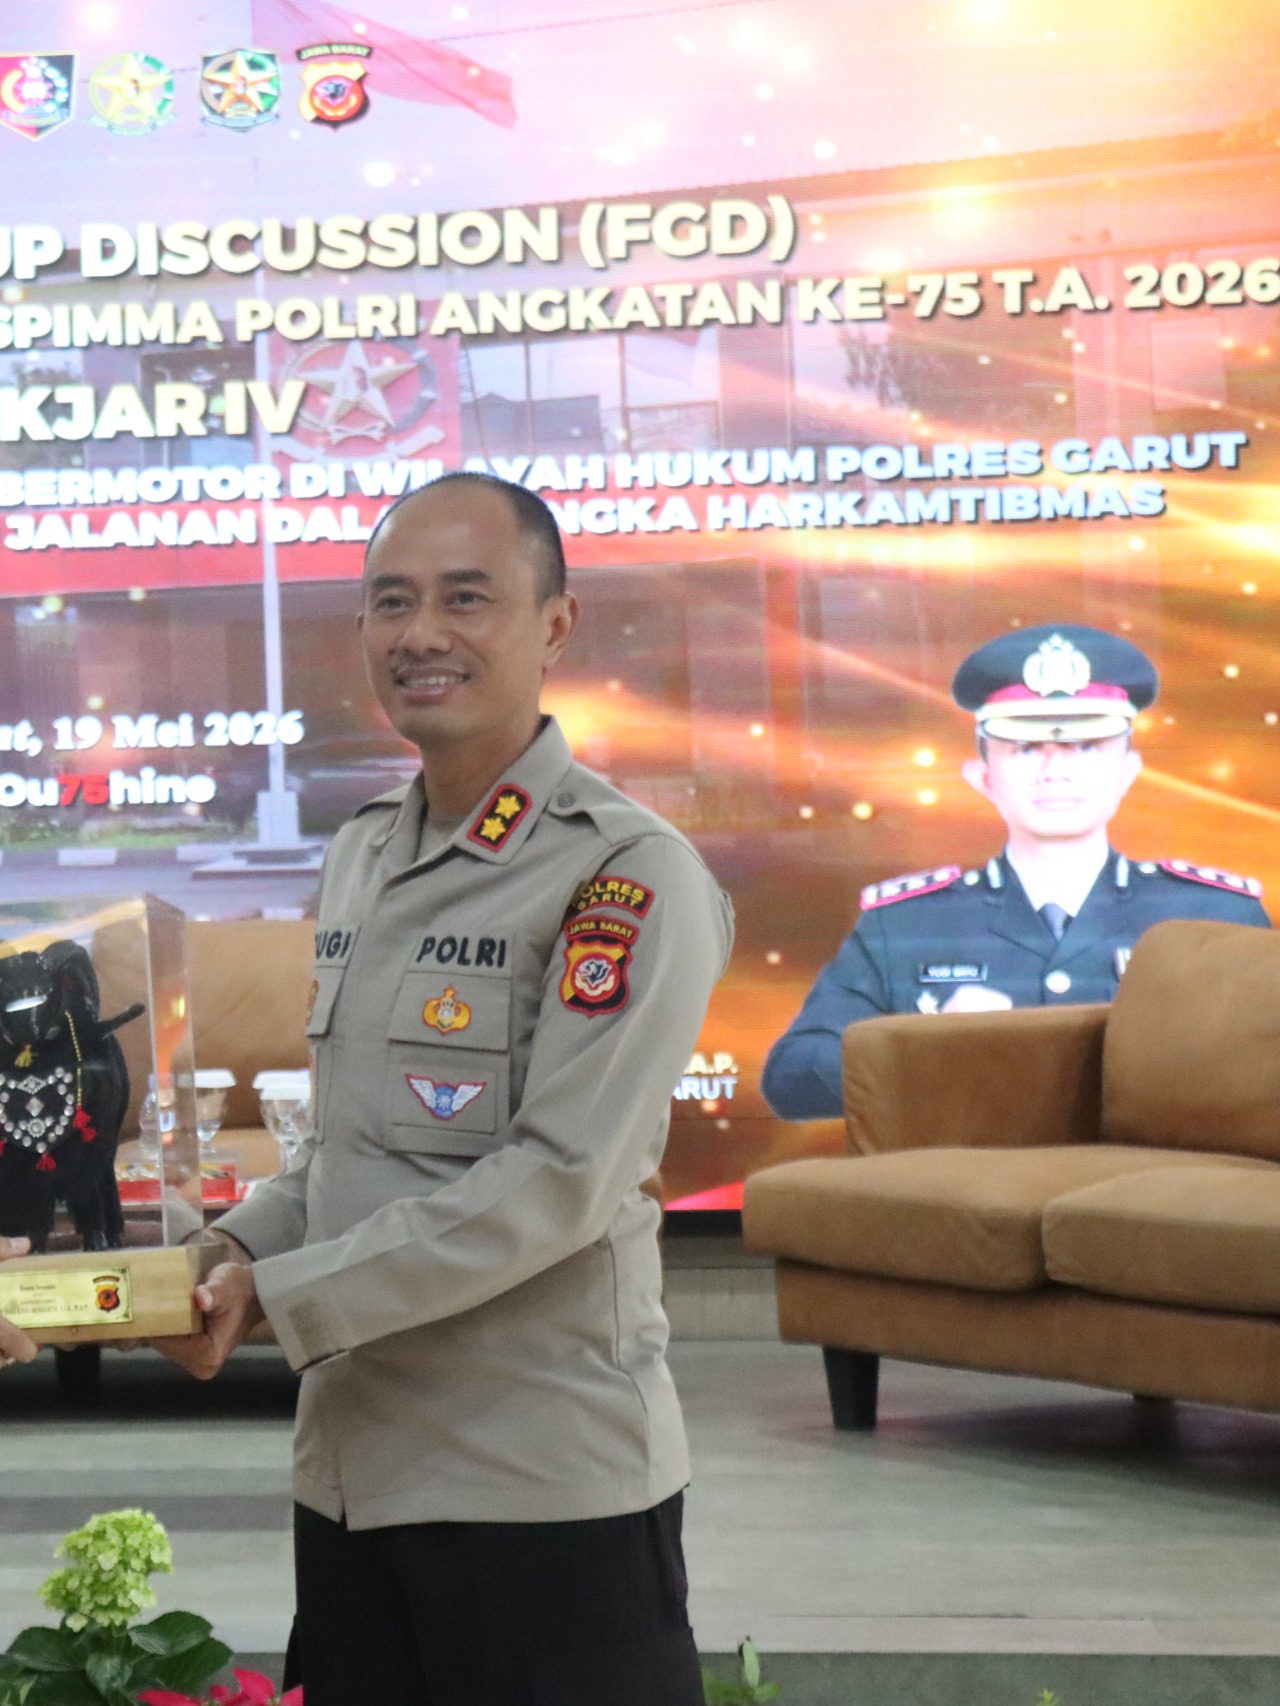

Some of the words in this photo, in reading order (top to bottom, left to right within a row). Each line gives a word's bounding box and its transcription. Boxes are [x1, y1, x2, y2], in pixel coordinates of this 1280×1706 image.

[79, 207, 561, 280] DISCUSSION
[579, 194, 797, 270] (FGD)
[235, 290, 418, 343] POLRI
[430, 279, 783, 337] ANGKATAN
[795, 269, 981, 324] KE-75
[992, 264, 1111, 315] T.A.
[1122, 258, 1279, 309] 2026
[225, 379, 310, 436] IV
[289, 461, 347, 499] DI
[614, 445, 816, 490] HUKUM
[825, 438, 1044, 484] POLRES
[1050, 430, 1248, 475] GARUT
[4, 506, 259, 552] JALANAN
[270, 502, 392, 546] DAL
[544, 494, 697, 536] NGKA
[708, 481, 1167, 532] HARKAMTIBMAS
[52, 714, 104, 751] 19
[111, 711, 197, 749] Mei
[203, 709, 306, 747] 2026
[578, 880, 645, 904] OLRES
[314, 928, 352, 960] UGI
[416, 936, 507, 969] POLRI
[569, 921, 596, 935] JAWA
[600, 921, 634, 939] BARAT
